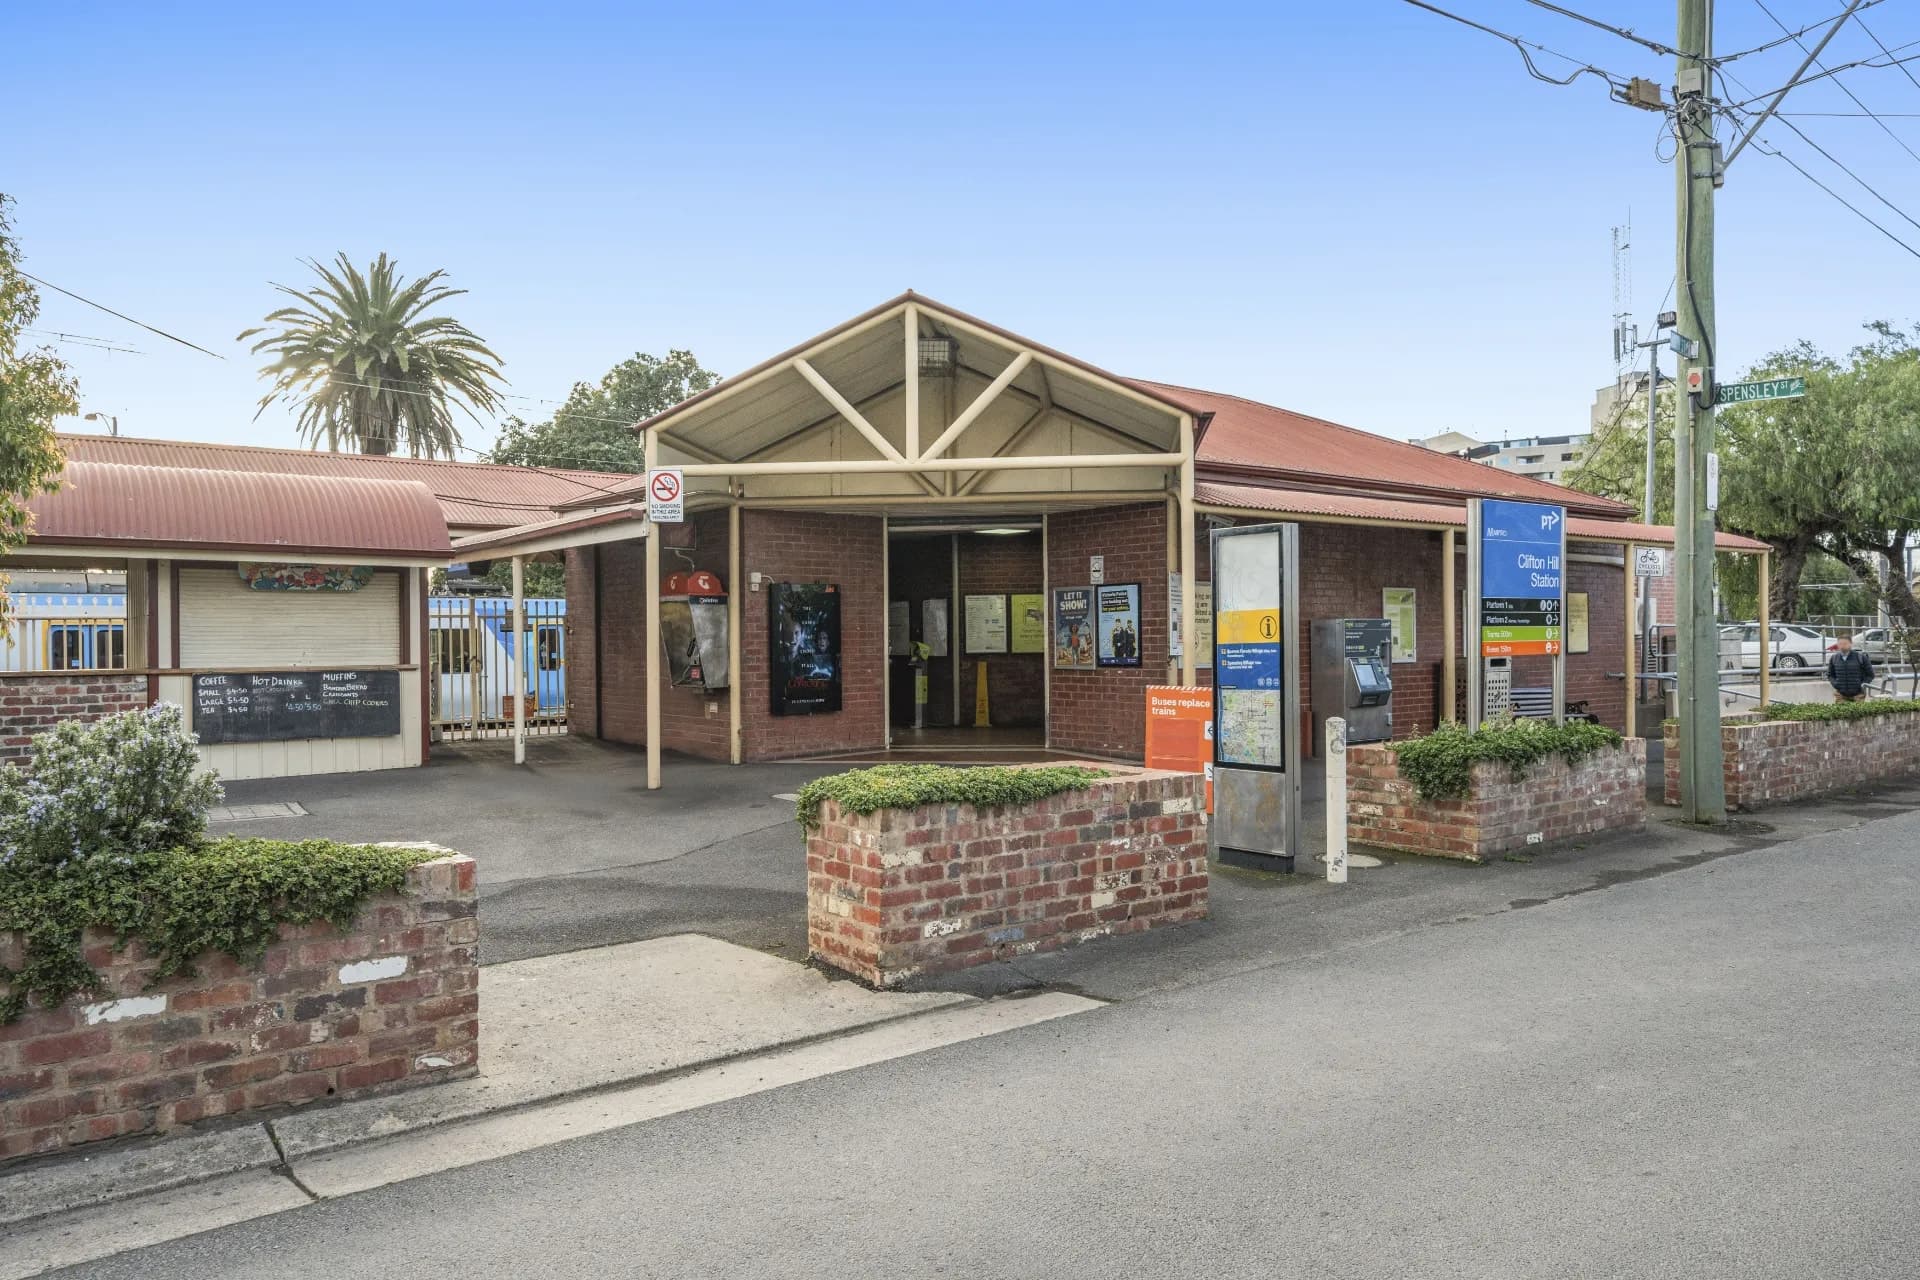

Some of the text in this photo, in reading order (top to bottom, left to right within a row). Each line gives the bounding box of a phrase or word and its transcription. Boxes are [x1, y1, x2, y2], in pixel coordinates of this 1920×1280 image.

[1720, 381, 1788, 402] SPENSLEY ST
[1518, 554, 1560, 571] Clifton Hill
[1530, 573, 1559, 589] Station
[1063, 591, 1082, 600] LET IT
[1059, 599, 1087, 611] SHOW!
[1504, 616, 1508, 624] 2
[199, 676, 229, 686] COFFEE
[252, 675, 303, 687] HOT DRINKS
[322, 672, 357, 681] MUFFINS
[199, 698, 224, 706] LARGE
[344, 698, 361, 706] CHIP
[1151, 696, 1211, 709] Buses replace
[1151, 707, 1177, 716] trains
